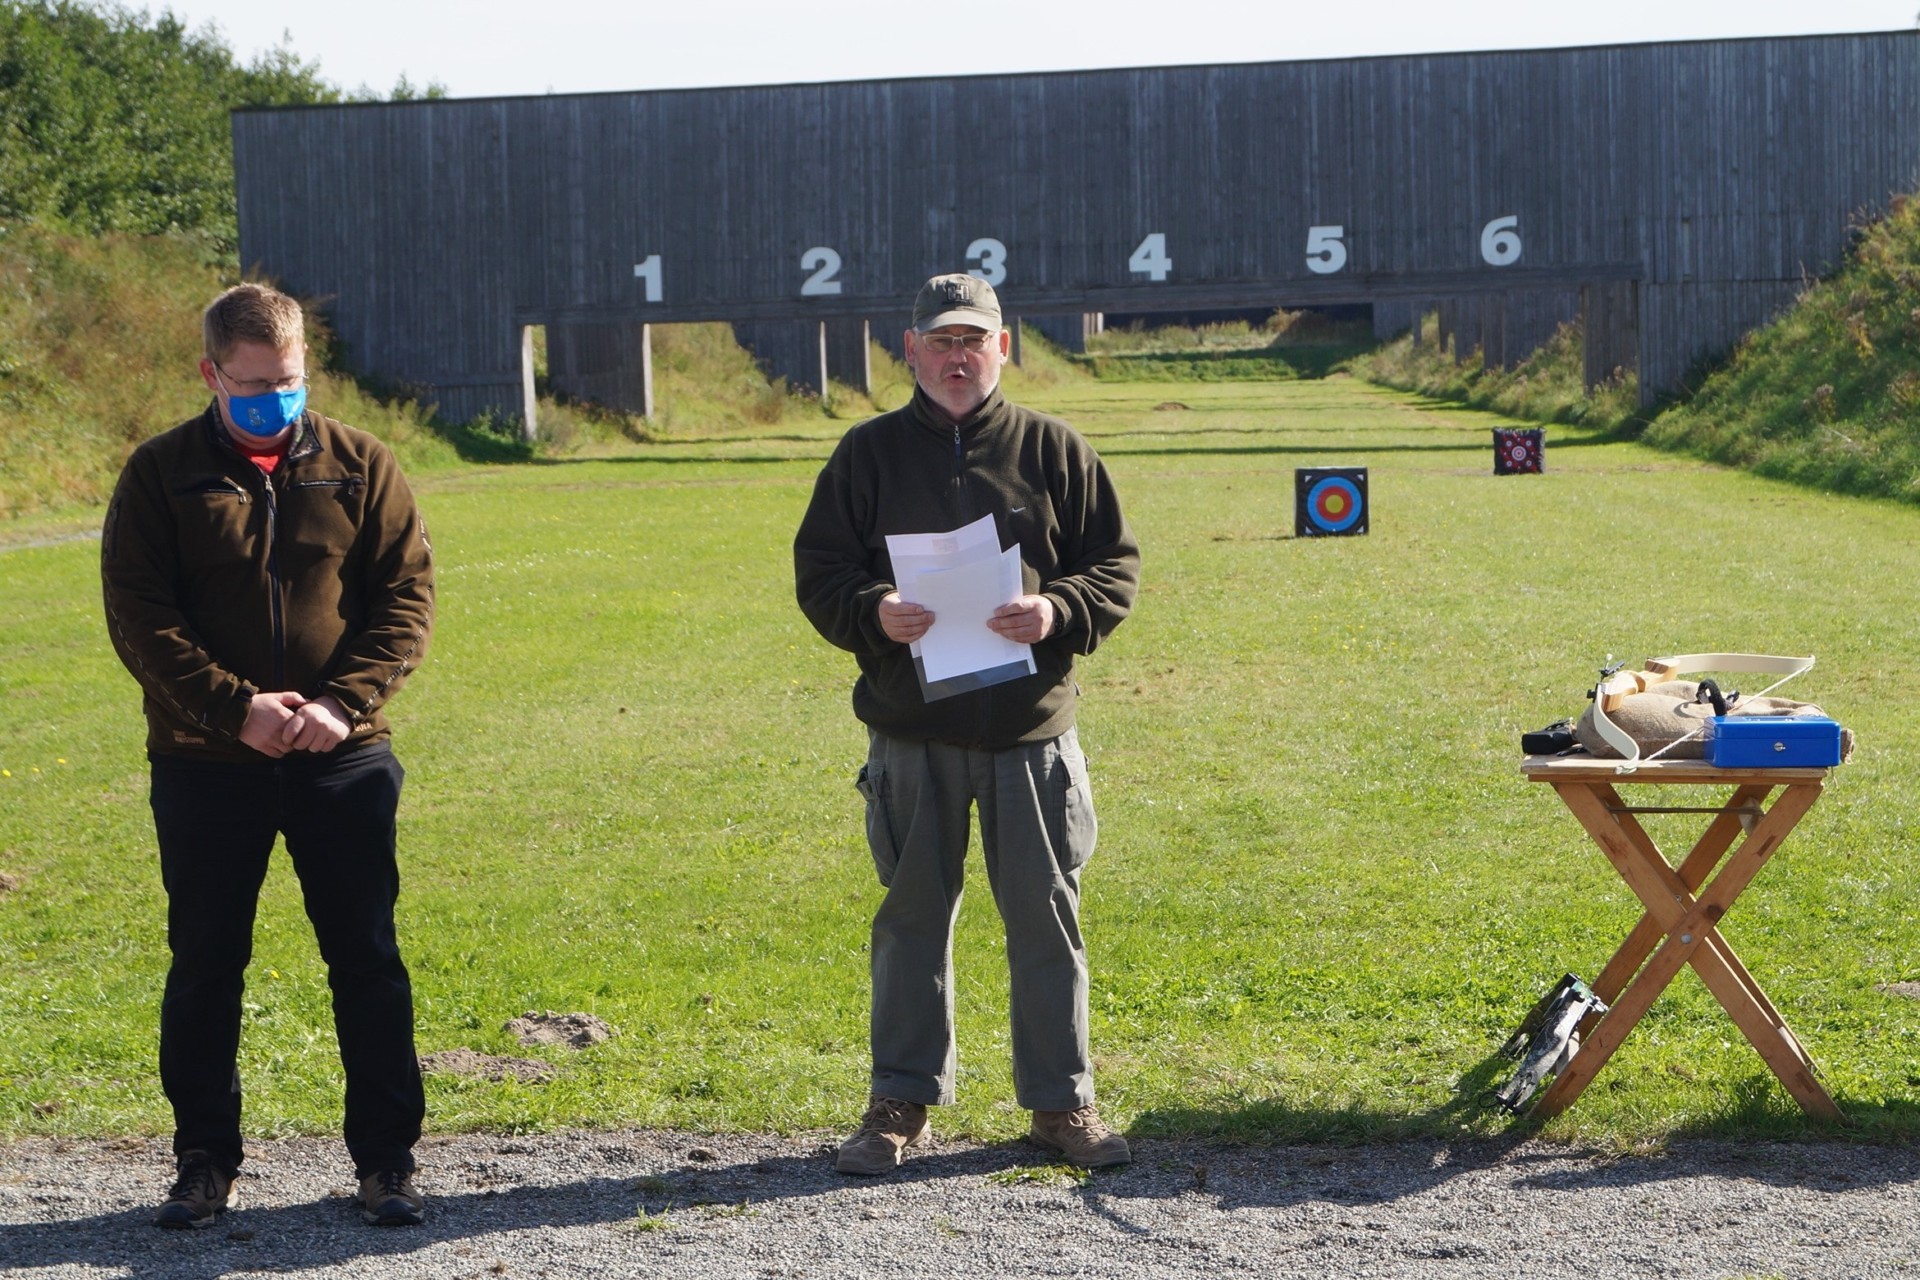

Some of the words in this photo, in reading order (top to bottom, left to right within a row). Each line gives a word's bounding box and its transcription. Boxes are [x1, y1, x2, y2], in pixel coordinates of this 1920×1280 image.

[634, 254, 663, 302] 1
[801, 247, 842, 296] 2
[966, 238, 1007, 287] 3
[1129, 233, 1172, 281] 4
[1306, 225, 1347, 274] 5
[1480, 215, 1522, 266] 6
